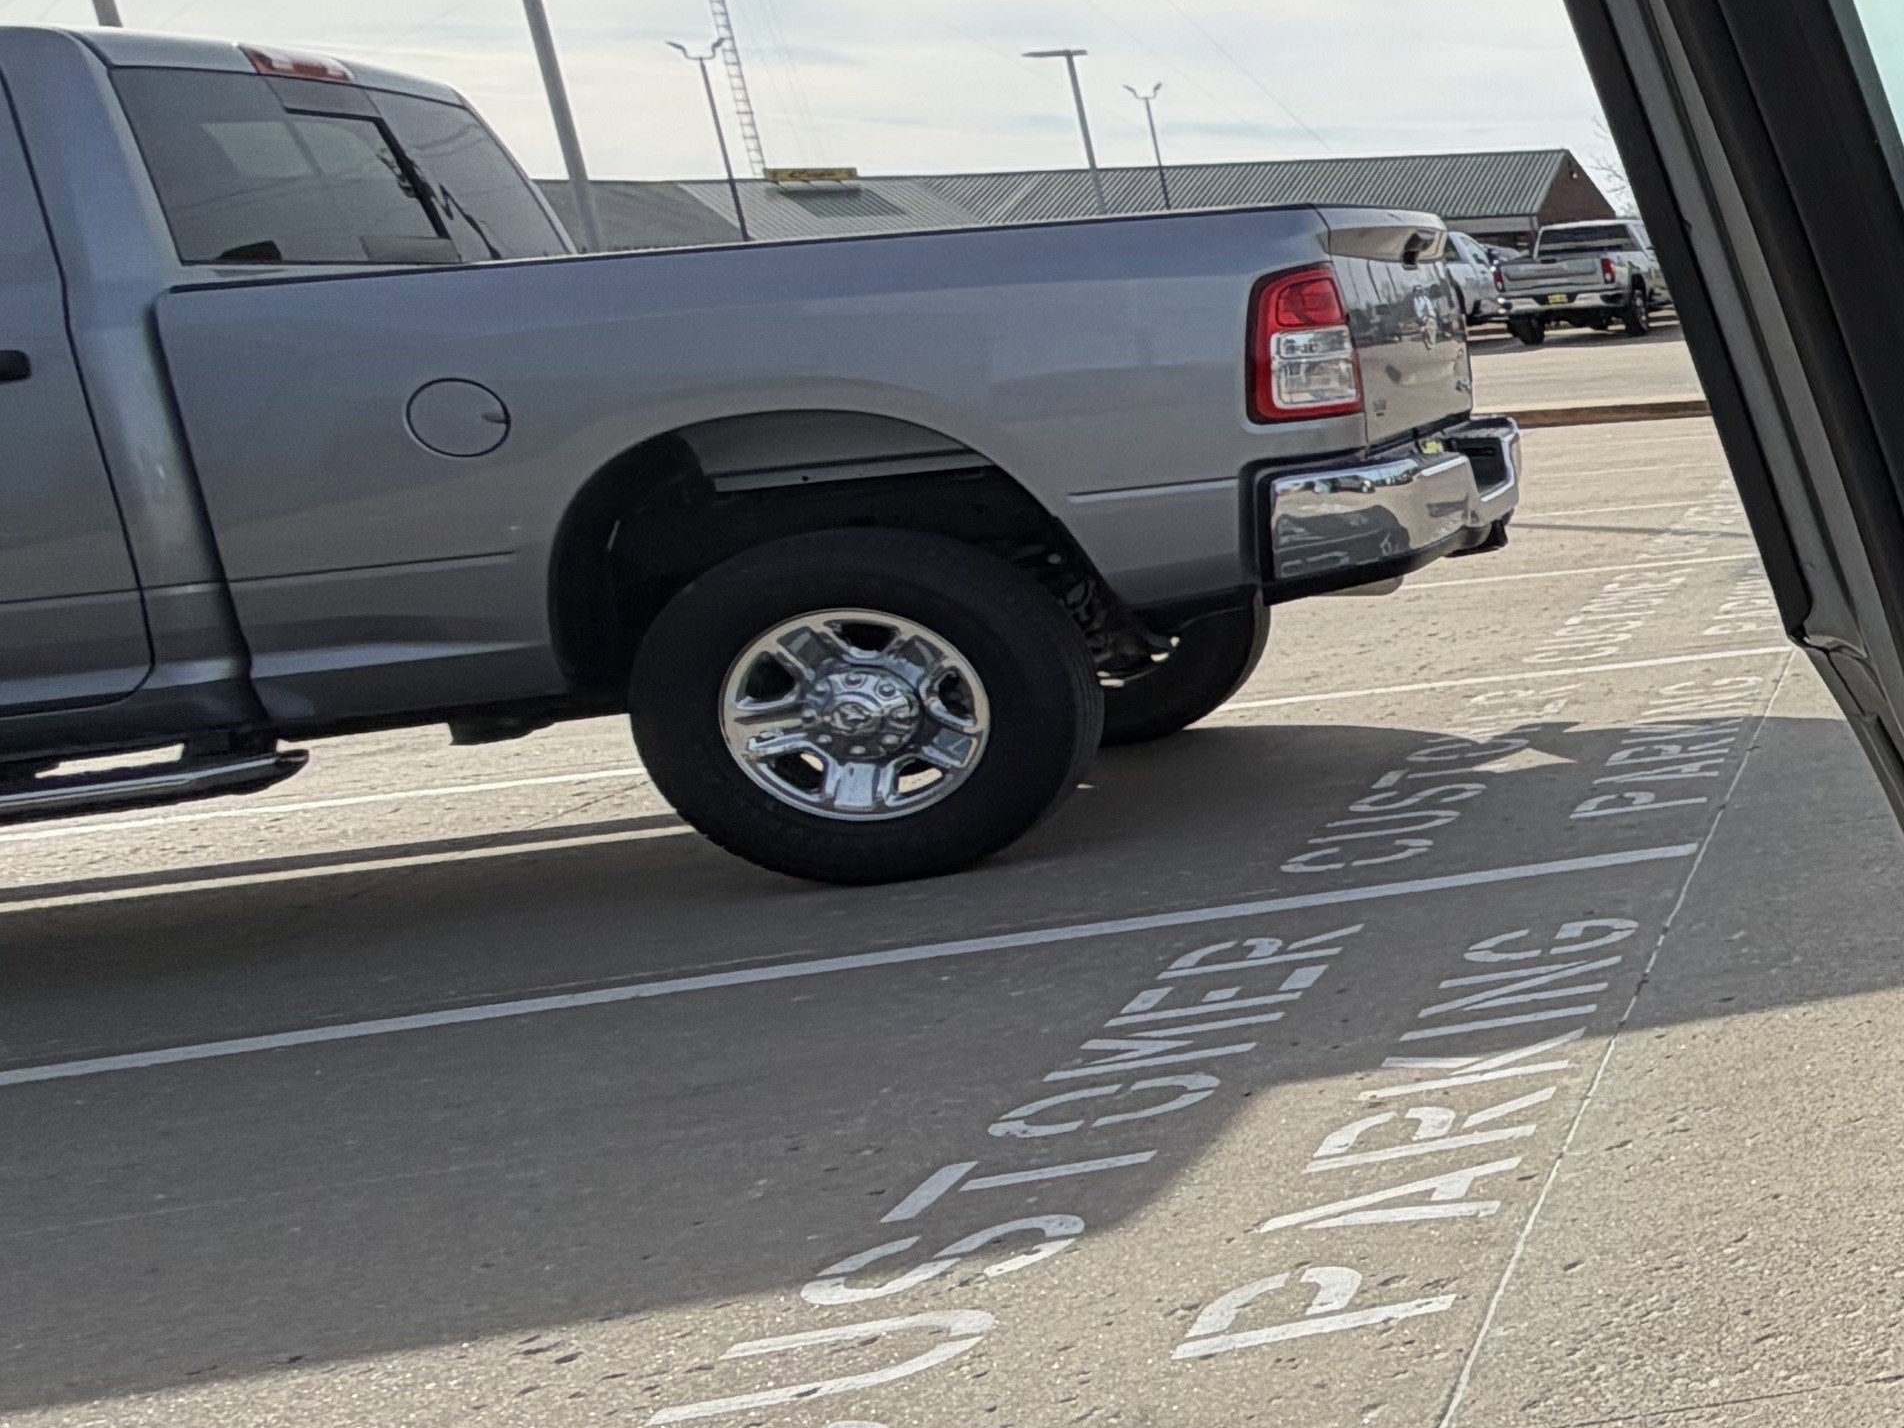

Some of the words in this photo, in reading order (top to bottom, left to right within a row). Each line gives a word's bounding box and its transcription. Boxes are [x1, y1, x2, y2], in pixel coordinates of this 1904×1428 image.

[1280, 682, 1585, 873] CUSTOMER
[1570, 676, 1763, 820] PARKING
[1170, 917, 1639, 1360] PARKING
